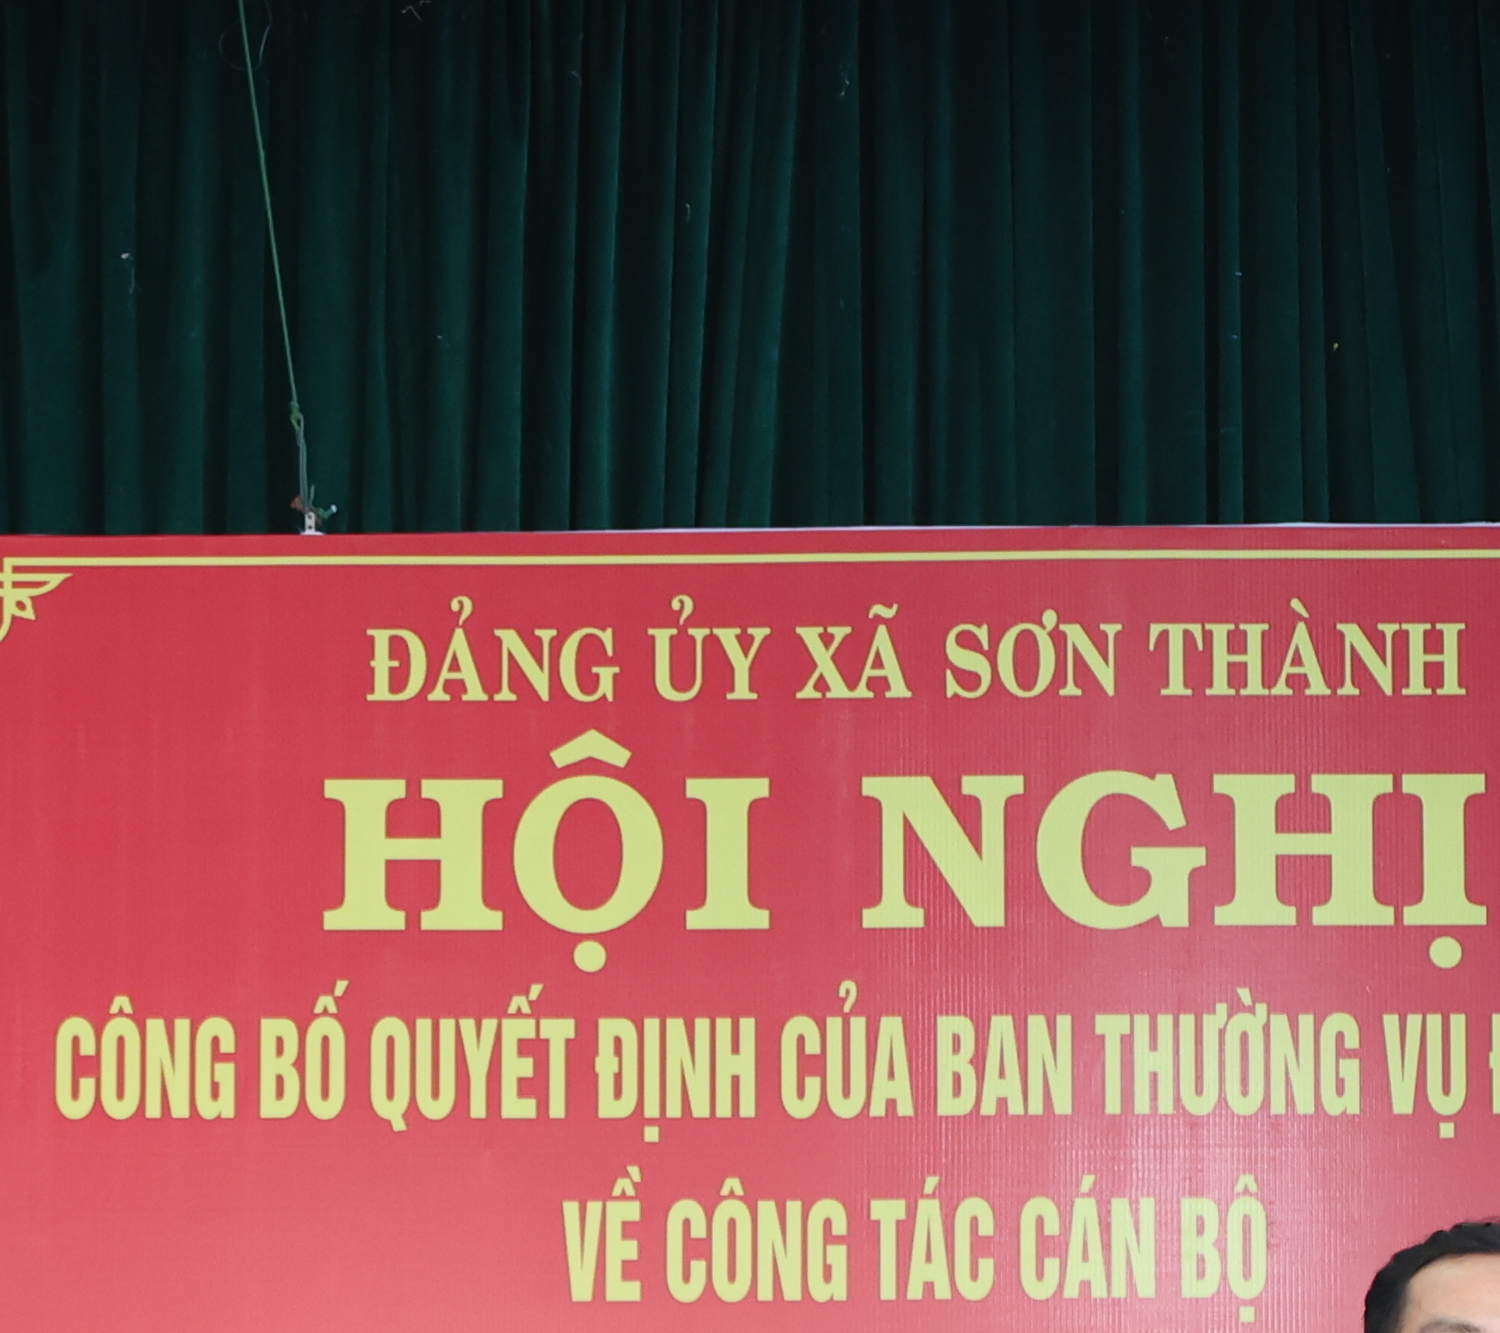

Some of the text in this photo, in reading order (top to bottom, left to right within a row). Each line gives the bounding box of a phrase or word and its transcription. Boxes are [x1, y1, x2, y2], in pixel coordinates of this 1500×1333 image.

[367, 595, 1467, 702] ĐẢNG ỦY XÃ SƠN THÀNH
[323, 729, 1487, 973] HỘI NGHỊ
[55, 995, 236, 1120] CÔNG
[260, 980, 349, 1120] BỐ
[370, 984, 576, 1132] QUYẾT
[595, 1017, 756, 1143] ĐỊNH
[780, 980, 915, 1119] CỦA
[936, 1013, 1073, 1117] BAN
[1094, 987, 1361, 1116] THƯỜNG
[1382, 1013, 1467, 1139] VỤ
[562, 1164, 1269, 1323] VỀ CÔNG TÁC CÁN BỘ
